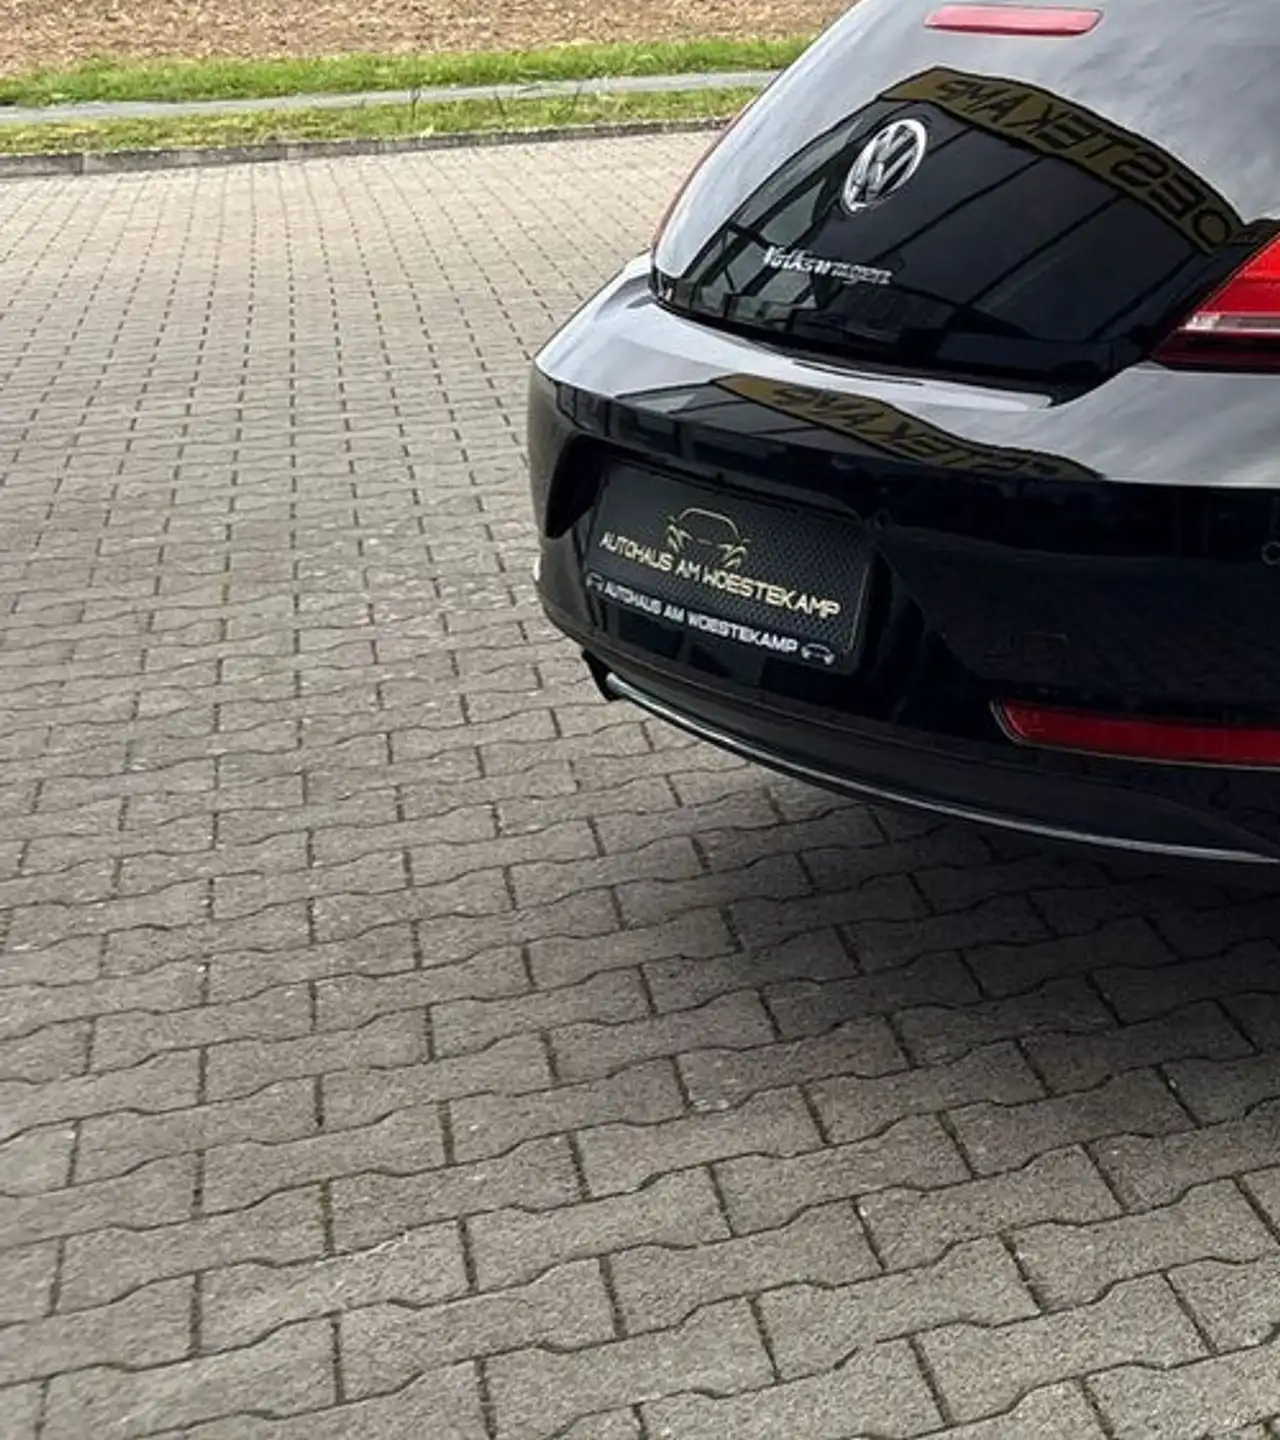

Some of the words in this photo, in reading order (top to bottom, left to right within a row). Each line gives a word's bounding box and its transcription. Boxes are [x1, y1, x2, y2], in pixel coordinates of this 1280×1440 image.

[598, 530, 675, 572] AUTOHAUS
[674, 558, 702, 581] AM
[701, 564, 842, 620] WOESTEKAMP
[603, 580, 663, 616] AUTOHAUS
[662, 603, 686, 624] AM
[686, 610, 799, 654] WOESTEKAMP
